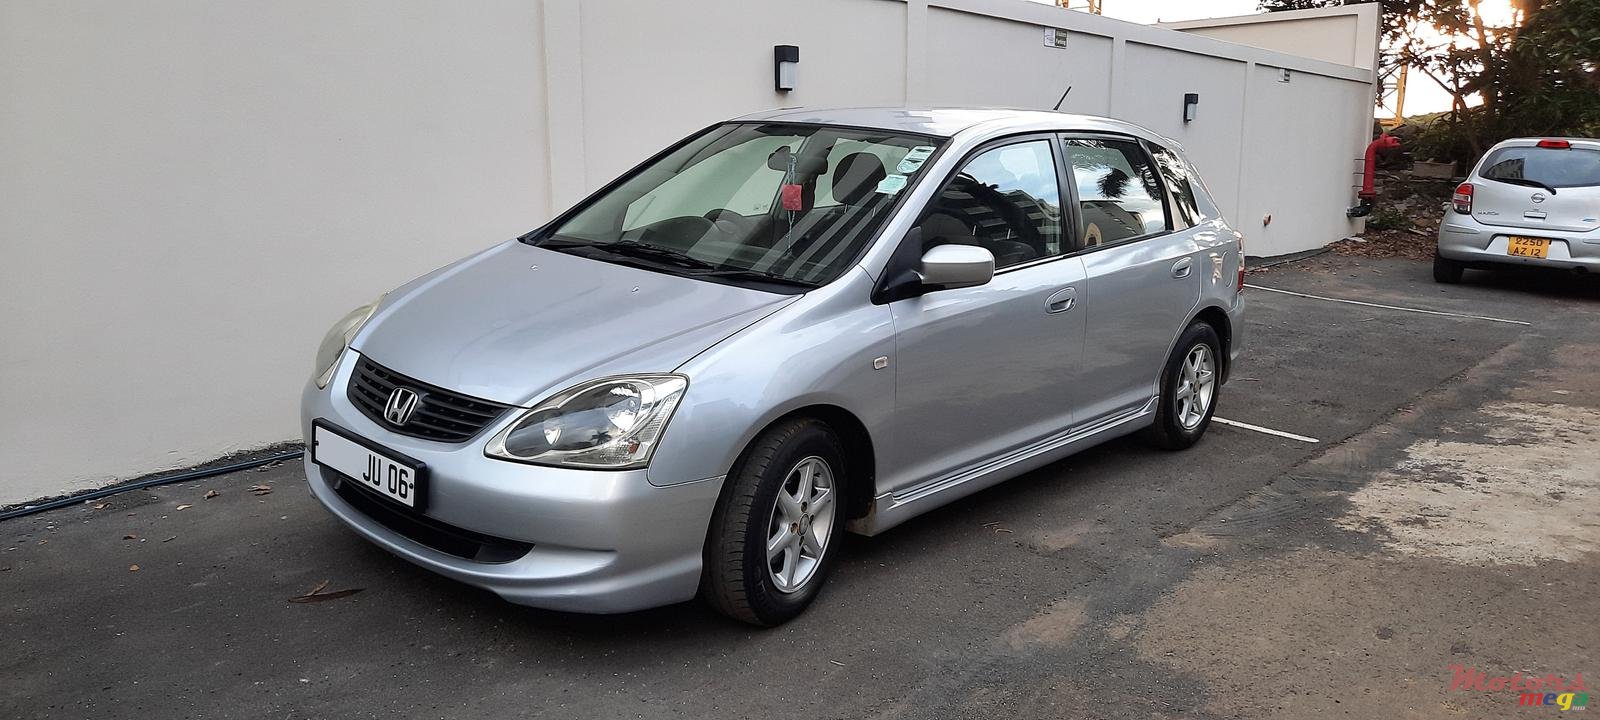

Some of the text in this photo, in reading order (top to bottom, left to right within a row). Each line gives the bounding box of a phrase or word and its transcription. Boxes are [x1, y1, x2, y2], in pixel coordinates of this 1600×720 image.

[1515, 237, 1543, 247] 2250
[1513, 248, 1541, 257] AZ 12
[363, 454, 408, 499] JU 06
